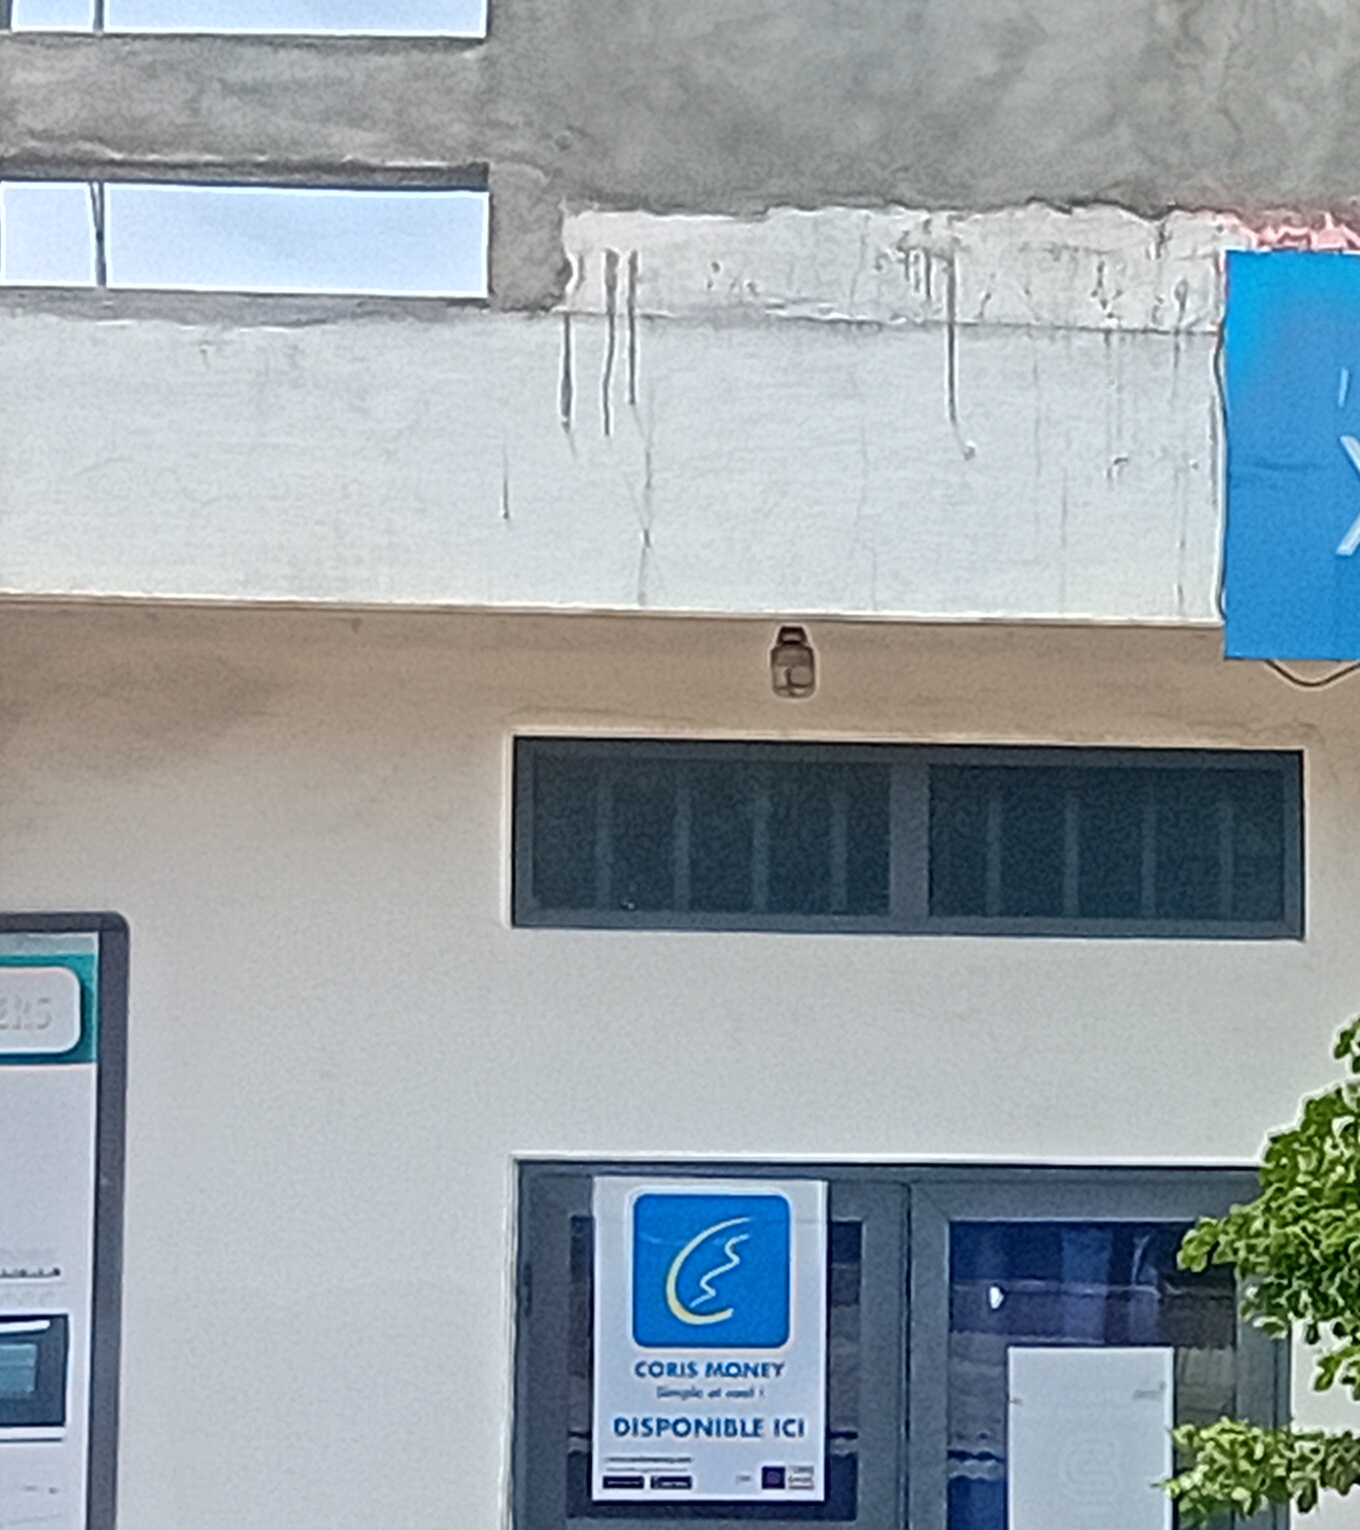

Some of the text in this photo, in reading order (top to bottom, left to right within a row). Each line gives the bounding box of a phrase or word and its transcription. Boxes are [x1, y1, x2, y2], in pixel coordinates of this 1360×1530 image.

[633, 1360, 786, 1379] CORIS MONEY
[613, 1416, 806, 1439] DISPONIBLE ICI
